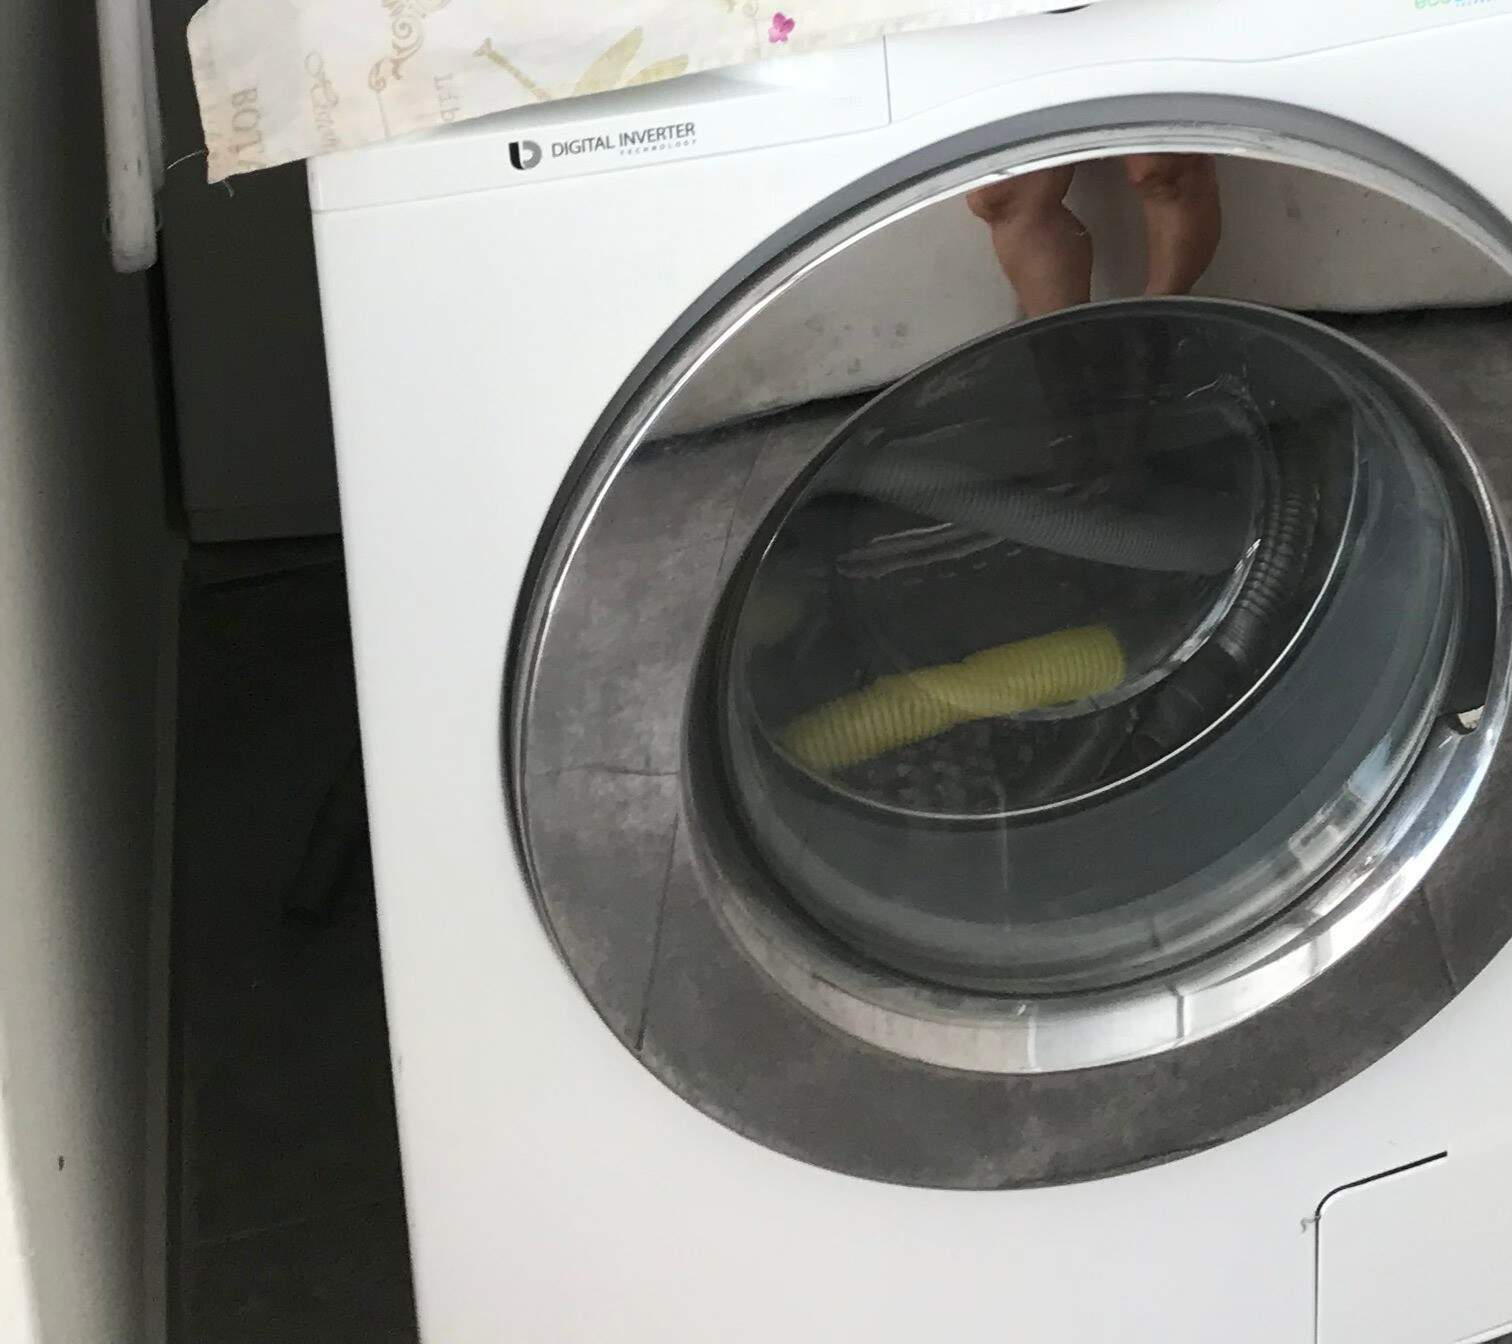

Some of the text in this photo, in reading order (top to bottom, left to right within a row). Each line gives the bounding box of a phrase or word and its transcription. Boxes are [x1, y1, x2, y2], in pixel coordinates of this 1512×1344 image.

[551, 121, 696, 158] DIGITAL INVERTER
[620, 138, 697, 156] TECHNOLOGY
